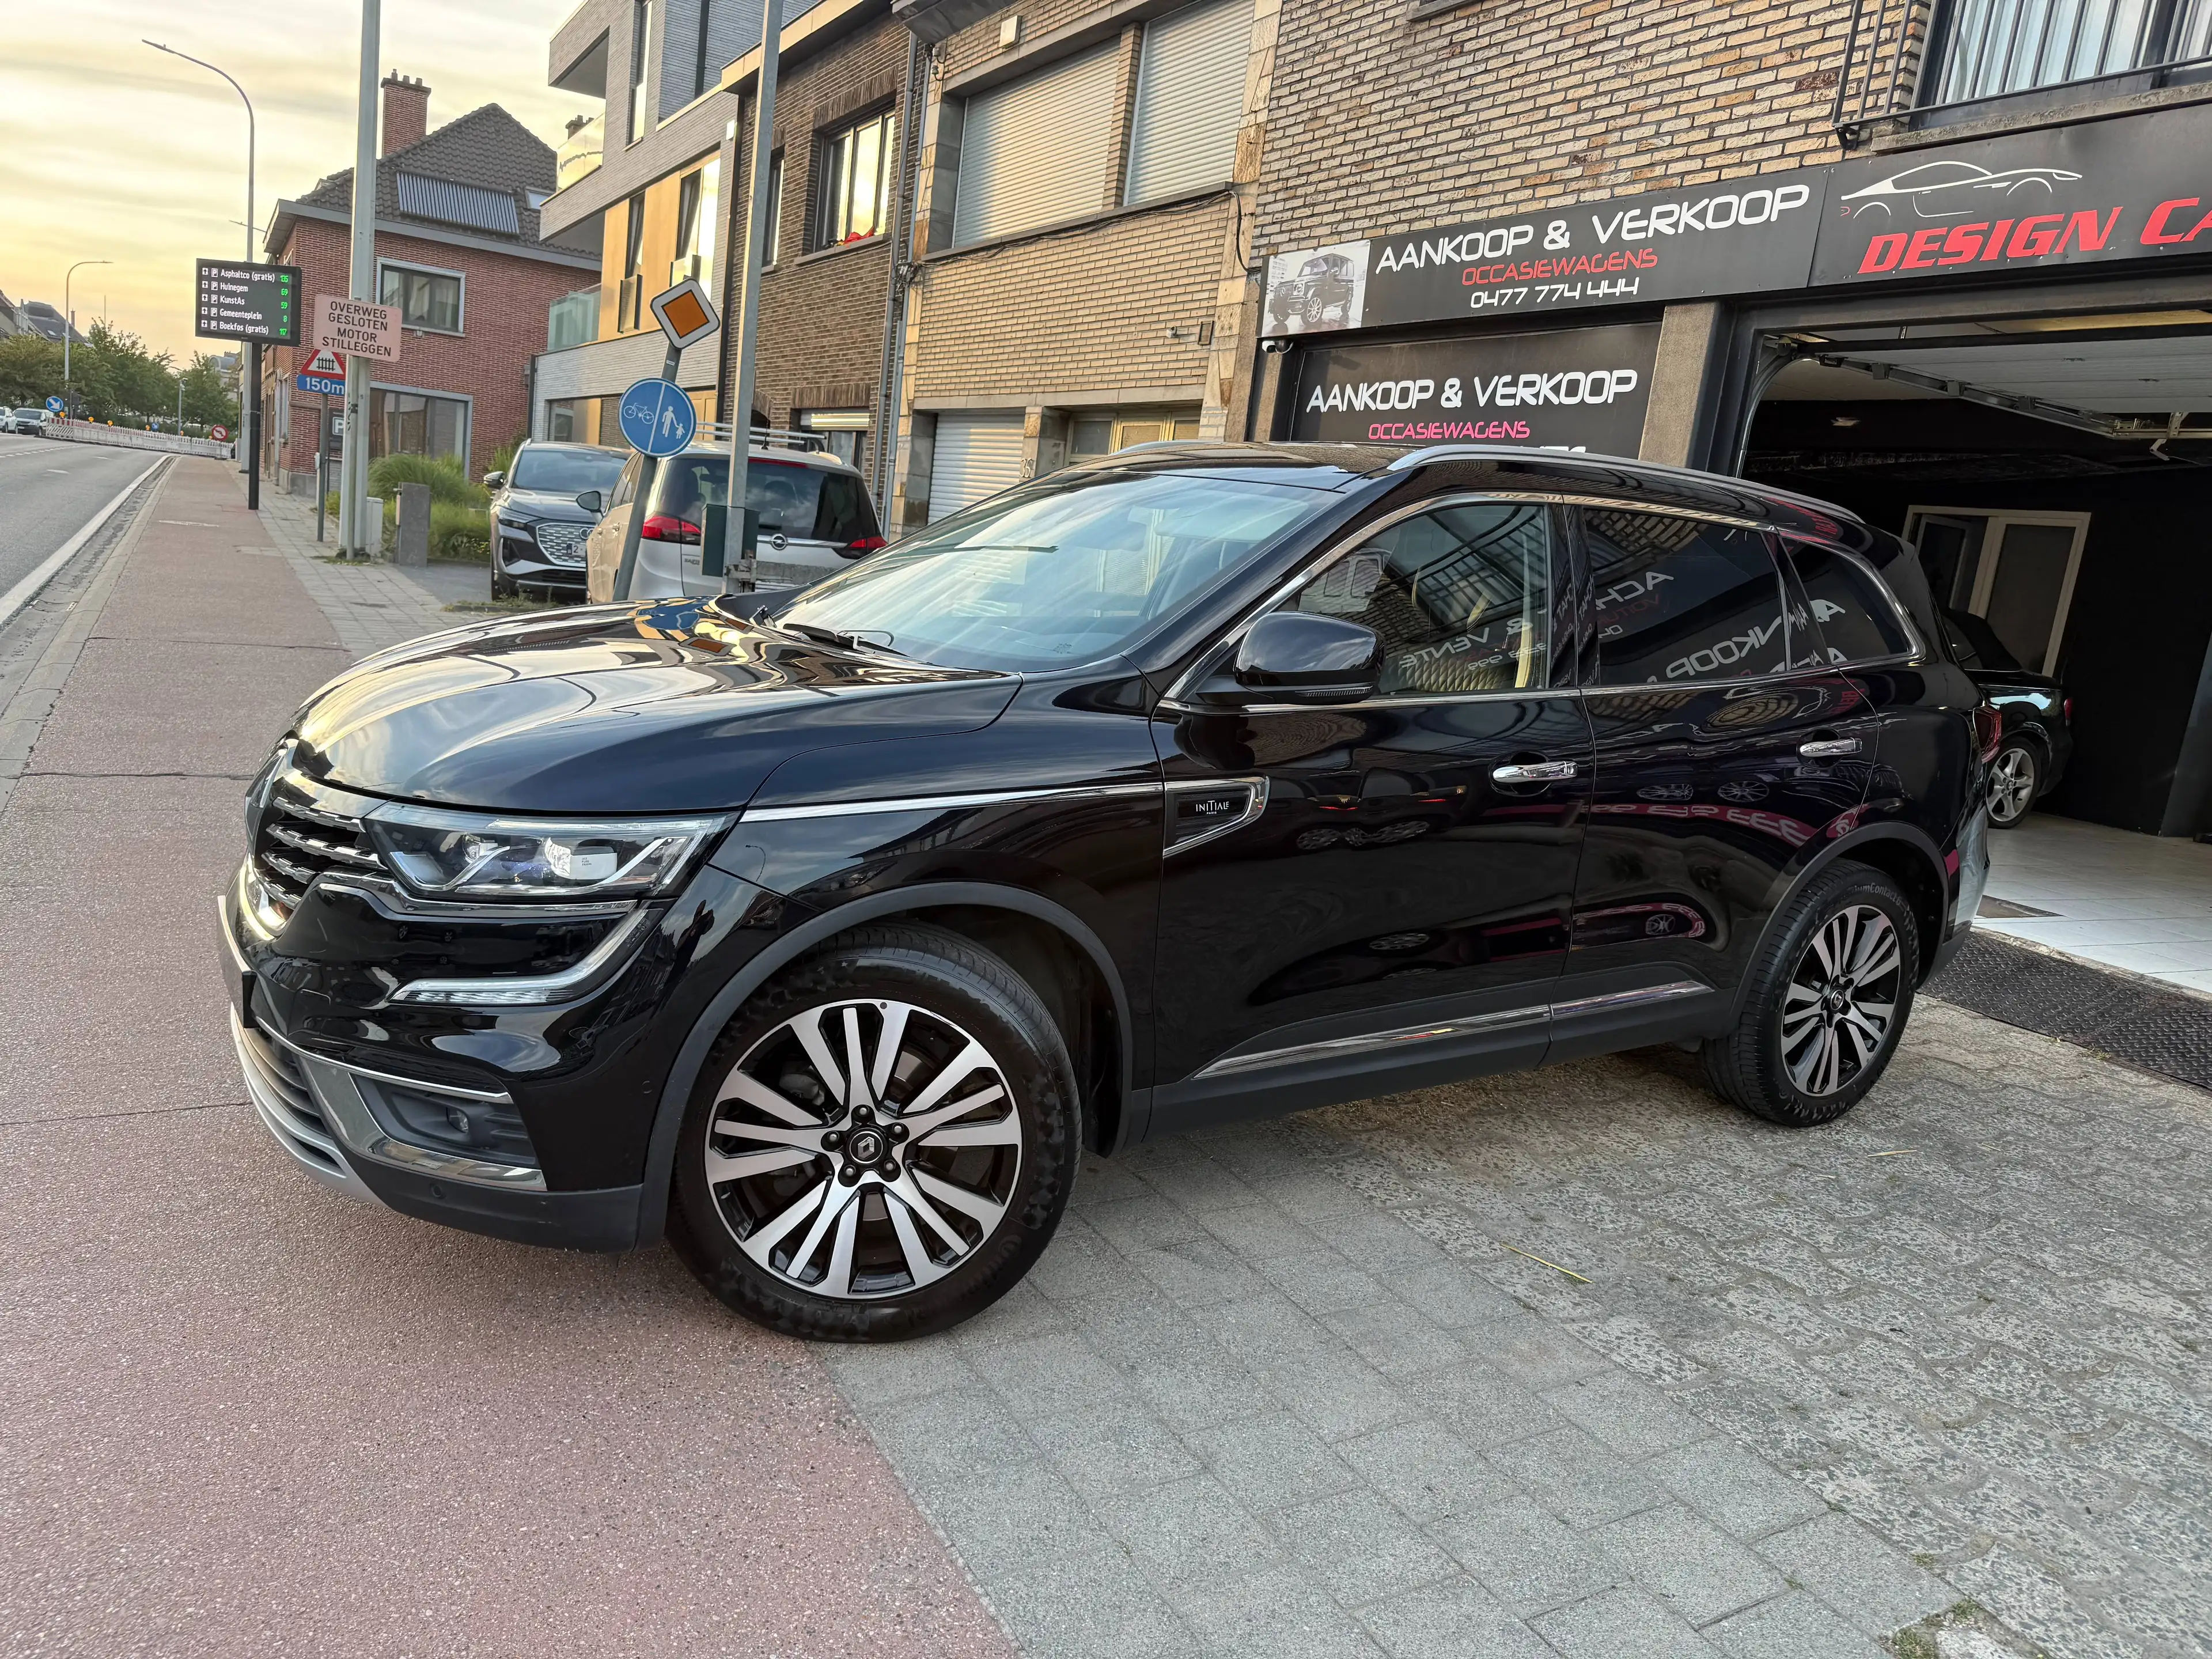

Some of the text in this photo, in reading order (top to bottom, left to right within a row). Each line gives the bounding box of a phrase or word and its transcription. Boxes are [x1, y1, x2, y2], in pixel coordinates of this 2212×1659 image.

[1376, 184, 1810, 274] AANKOOP & VERKOOP
[1858, 206, 2123, 274] DESIGN
[221, 269, 250, 279] Asphaltco
[252, 271, 275, 282] (gratis)
[1463, 248, 1658, 285] OCCASIEWAGENS
[220, 296, 245, 305] KunstAs
[1470, 276, 1640, 308] 0477 774 444
[220, 308, 262, 320] Gemeenteplein
[330, 301, 388, 319] OVERWEG
[219, 321, 244, 331] Boekfos
[245, 324, 269, 335] (gratis)
[328, 312, 388, 331] GESLOTEN
[337, 327, 378, 343] MOTOR
[322, 336, 392, 357] STILLEGGEN
[306, 377, 344, 395] 150m
[1306, 369, 1638, 413] AANKOOP & VERKOOP
[1369, 421, 1531, 440] OCCASIEWAGENS
[1196, 800, 1229, 812] INITIALE
